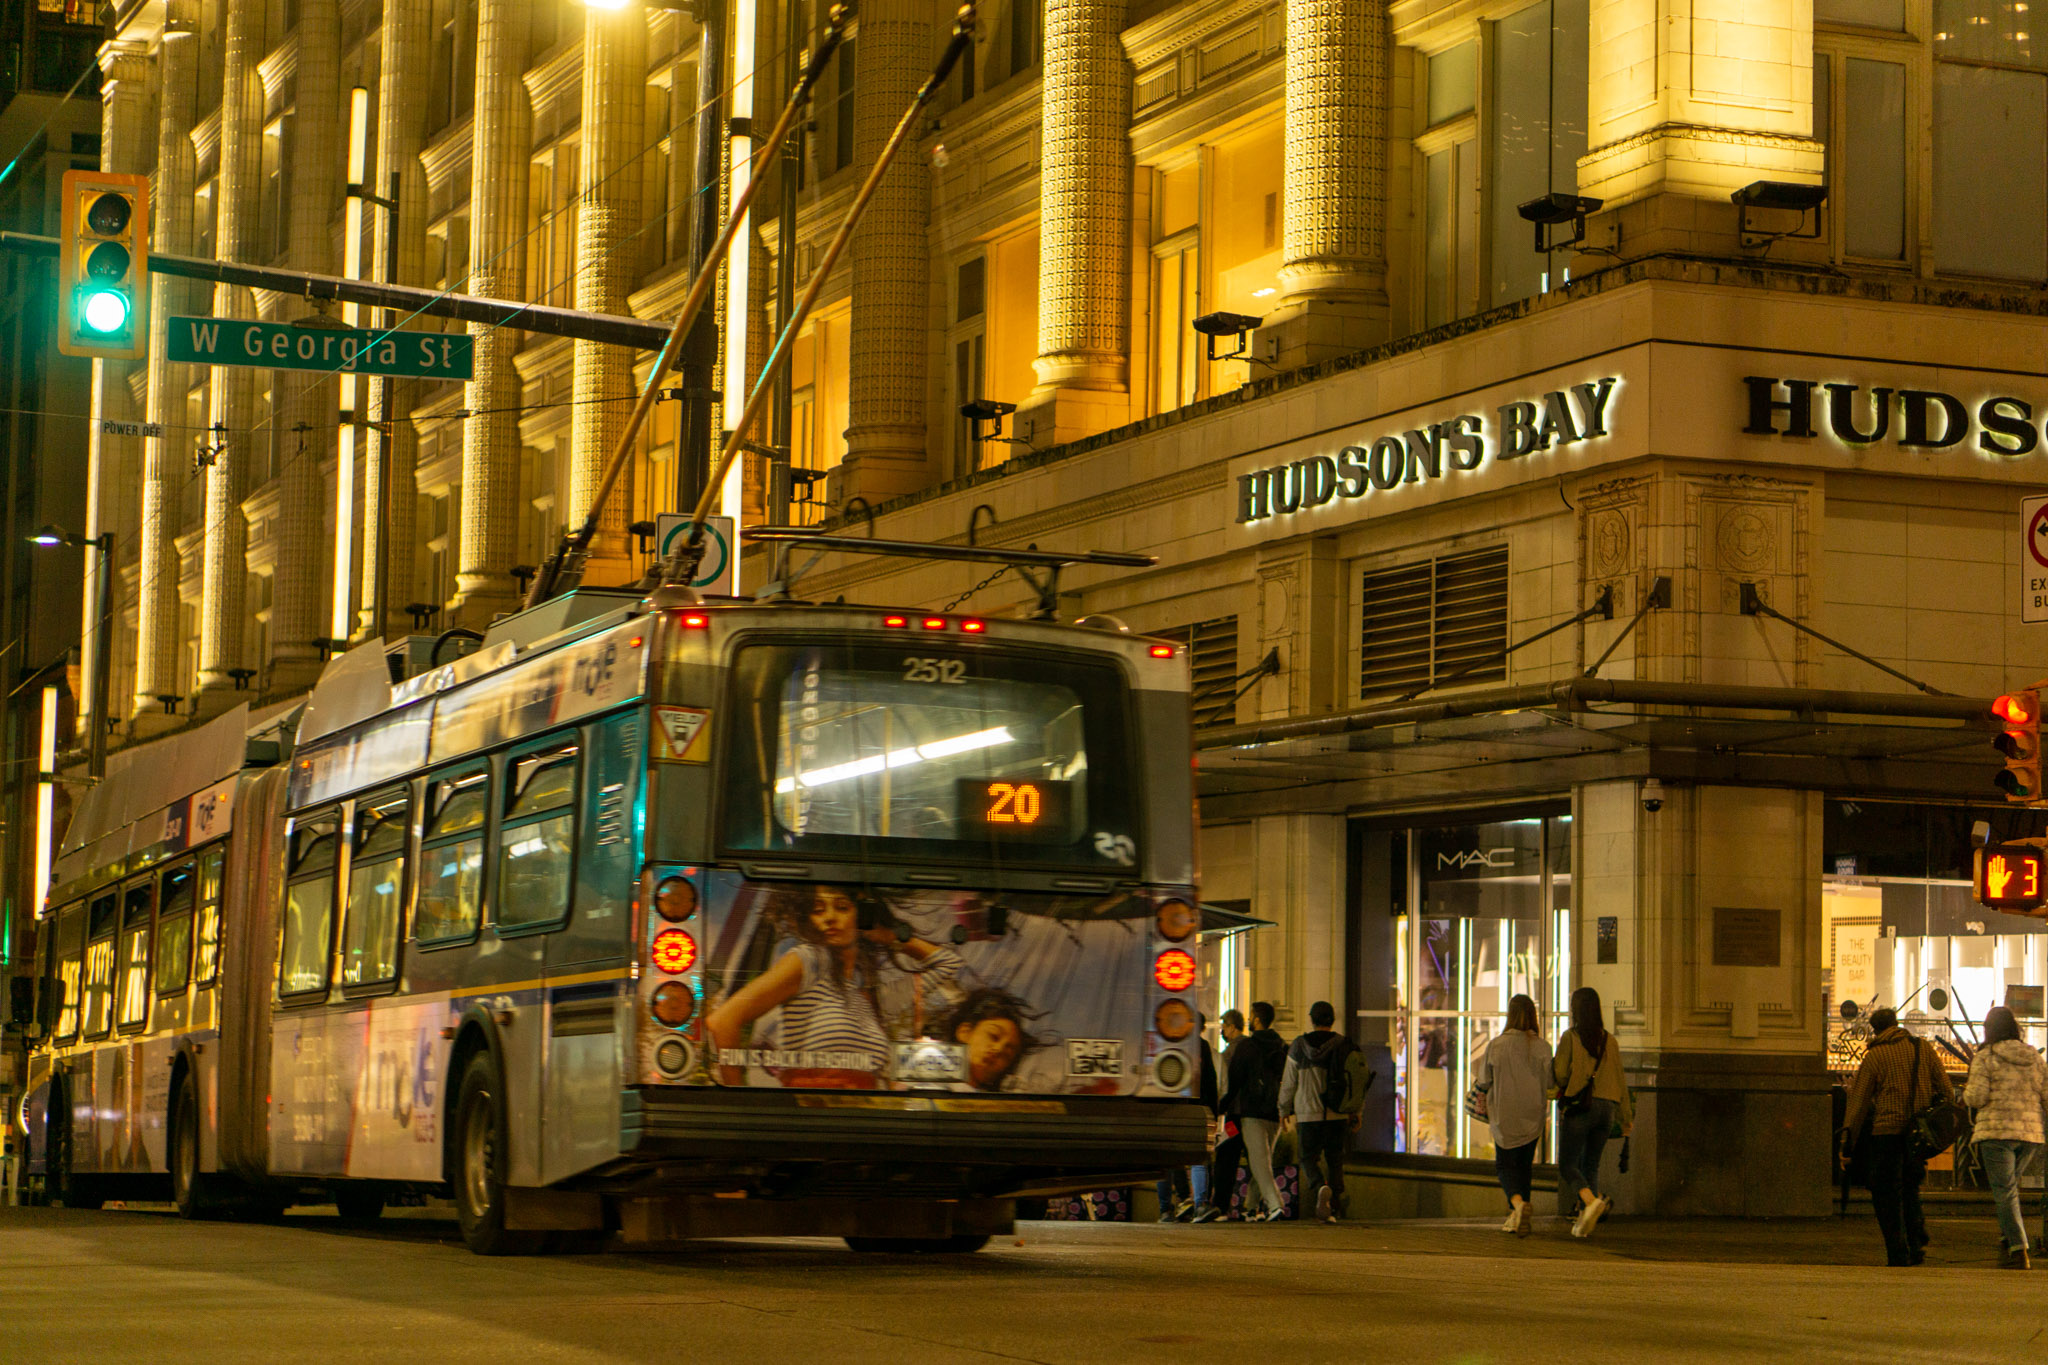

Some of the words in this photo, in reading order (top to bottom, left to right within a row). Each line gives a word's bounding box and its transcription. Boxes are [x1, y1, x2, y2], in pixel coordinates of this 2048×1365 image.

[191, 322, 219, 354] W
[243, 326, 397, 371] Georgia
[418, 337, 452, 369] St
[103, 422, 138, 436] POWER
[142, 425, 161, 438] OFF
[1743, 375, 2048, 456] HUDS
[1235, 414, 1484, 524] HUDSON'S
[1496, 377, 1617, 461] BAY
[902, 656, 967, 684] 2512
[987, 783, 1040, 823] 20
[2022, 859, 2038, 896] 3
[1841, 953, 1873, 967] BEAUTY
[1849, 938, 1865, 950] THE
